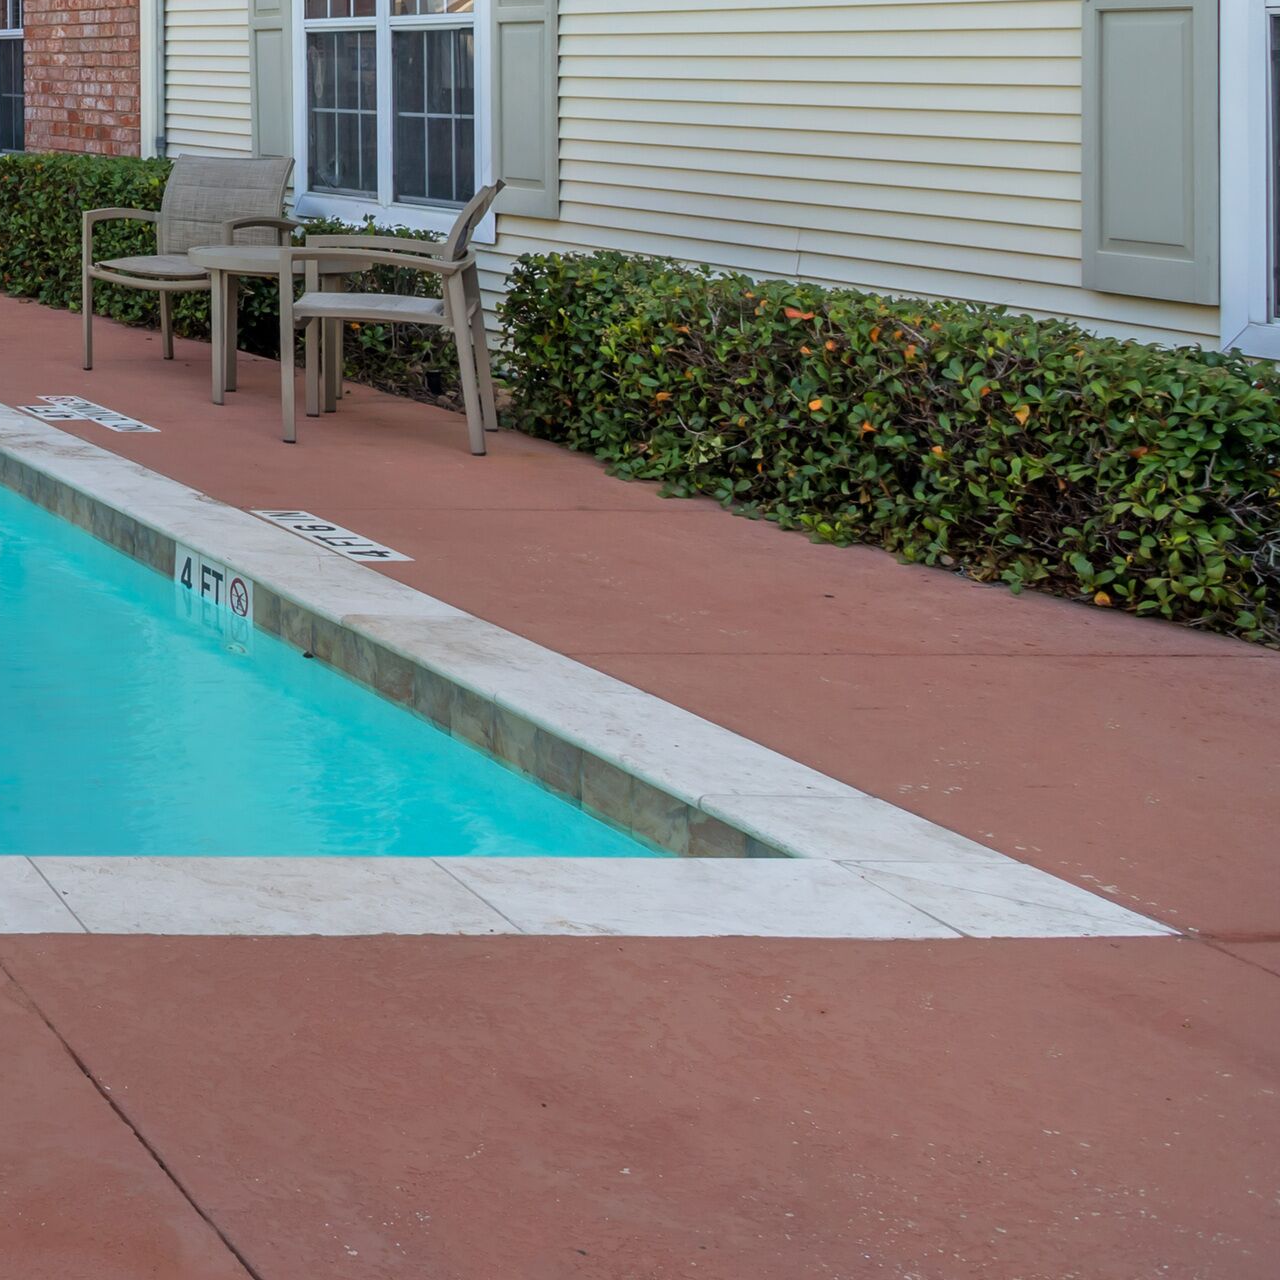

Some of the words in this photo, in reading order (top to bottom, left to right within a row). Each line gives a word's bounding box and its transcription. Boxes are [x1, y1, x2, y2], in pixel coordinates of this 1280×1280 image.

[261, 511, 317, 521] IN
[293, 524, 337, 532] 6
[312, 535, 375, 547] FT
[346, 550, 392, 558] 4
[181, 556, 193, 590] 4
[201, 563, 224, 606] FT
